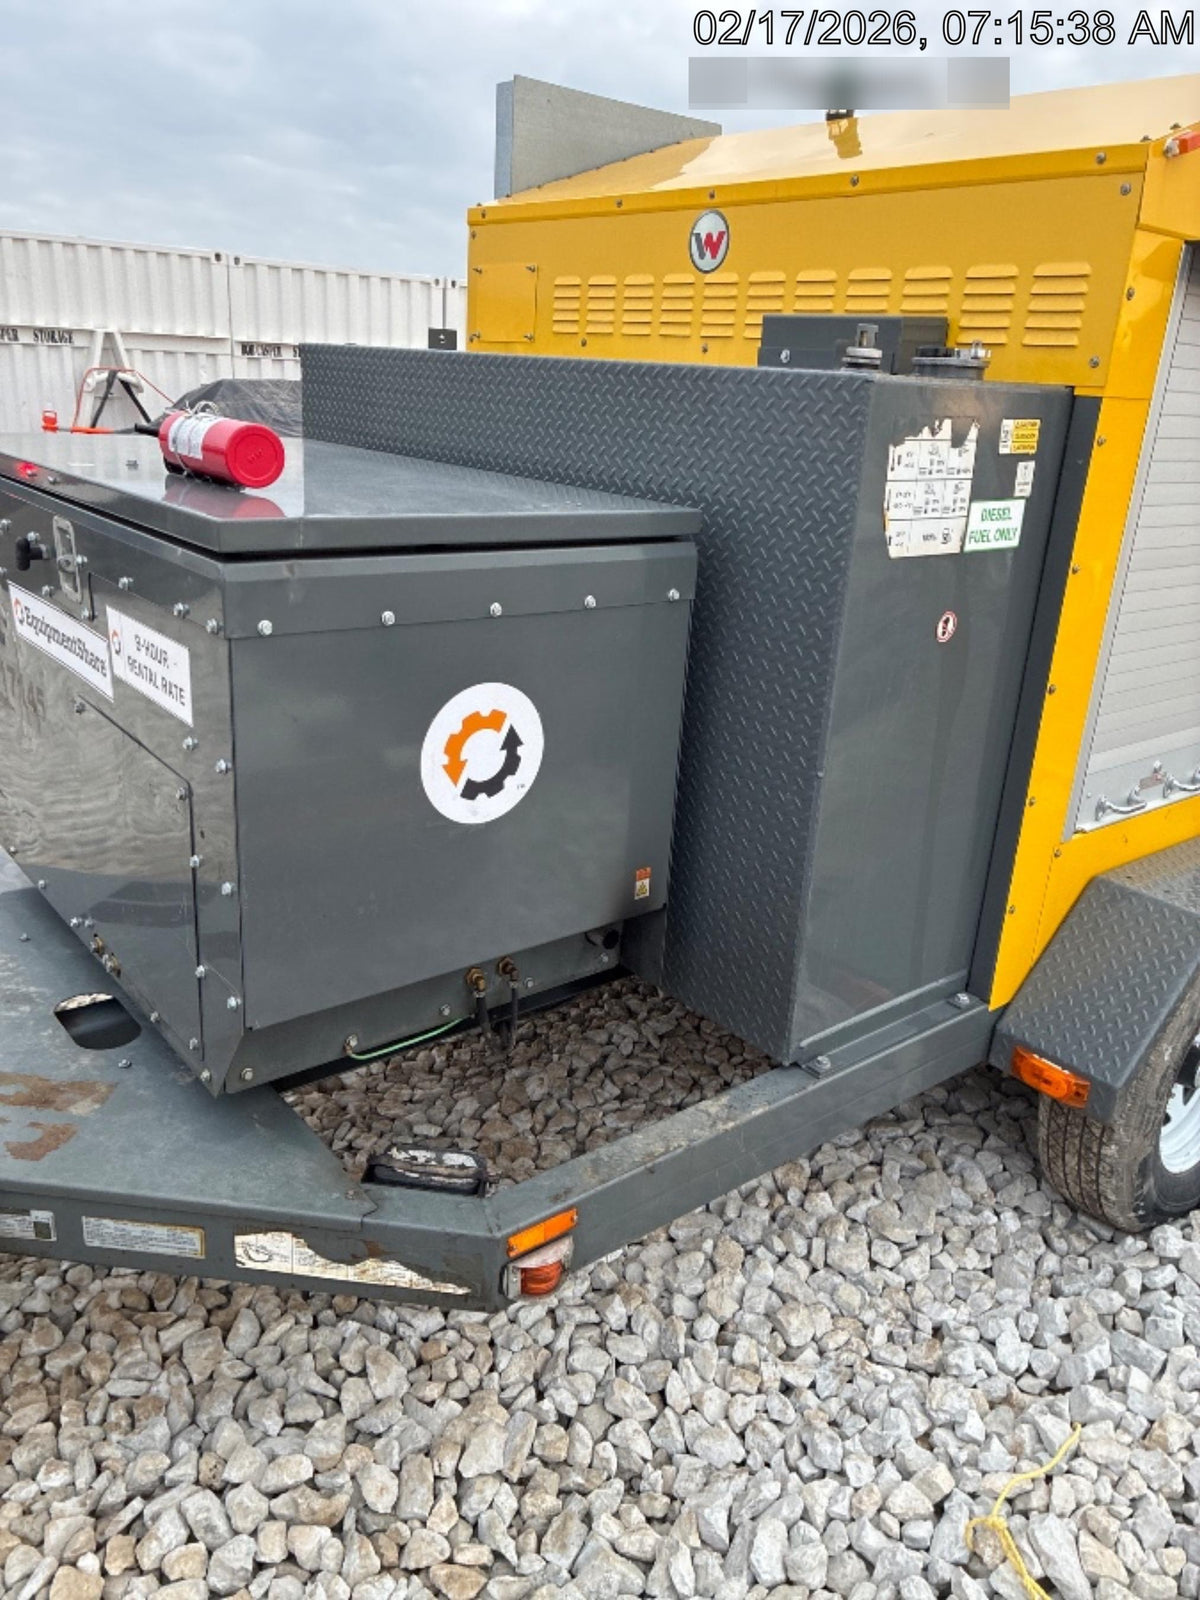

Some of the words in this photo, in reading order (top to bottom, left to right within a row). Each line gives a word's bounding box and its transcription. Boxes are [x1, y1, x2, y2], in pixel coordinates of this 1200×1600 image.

[980, 507, 1012, 522] DIESEL
[968, 530, 991, 545] FUEL
[993, 527, 1019, 542] ONLY
[24, 605, 108, 679] EquipmentShare
[127, 655, 159, 690] RENTAL
[161, 675, 186, 707] RATE
